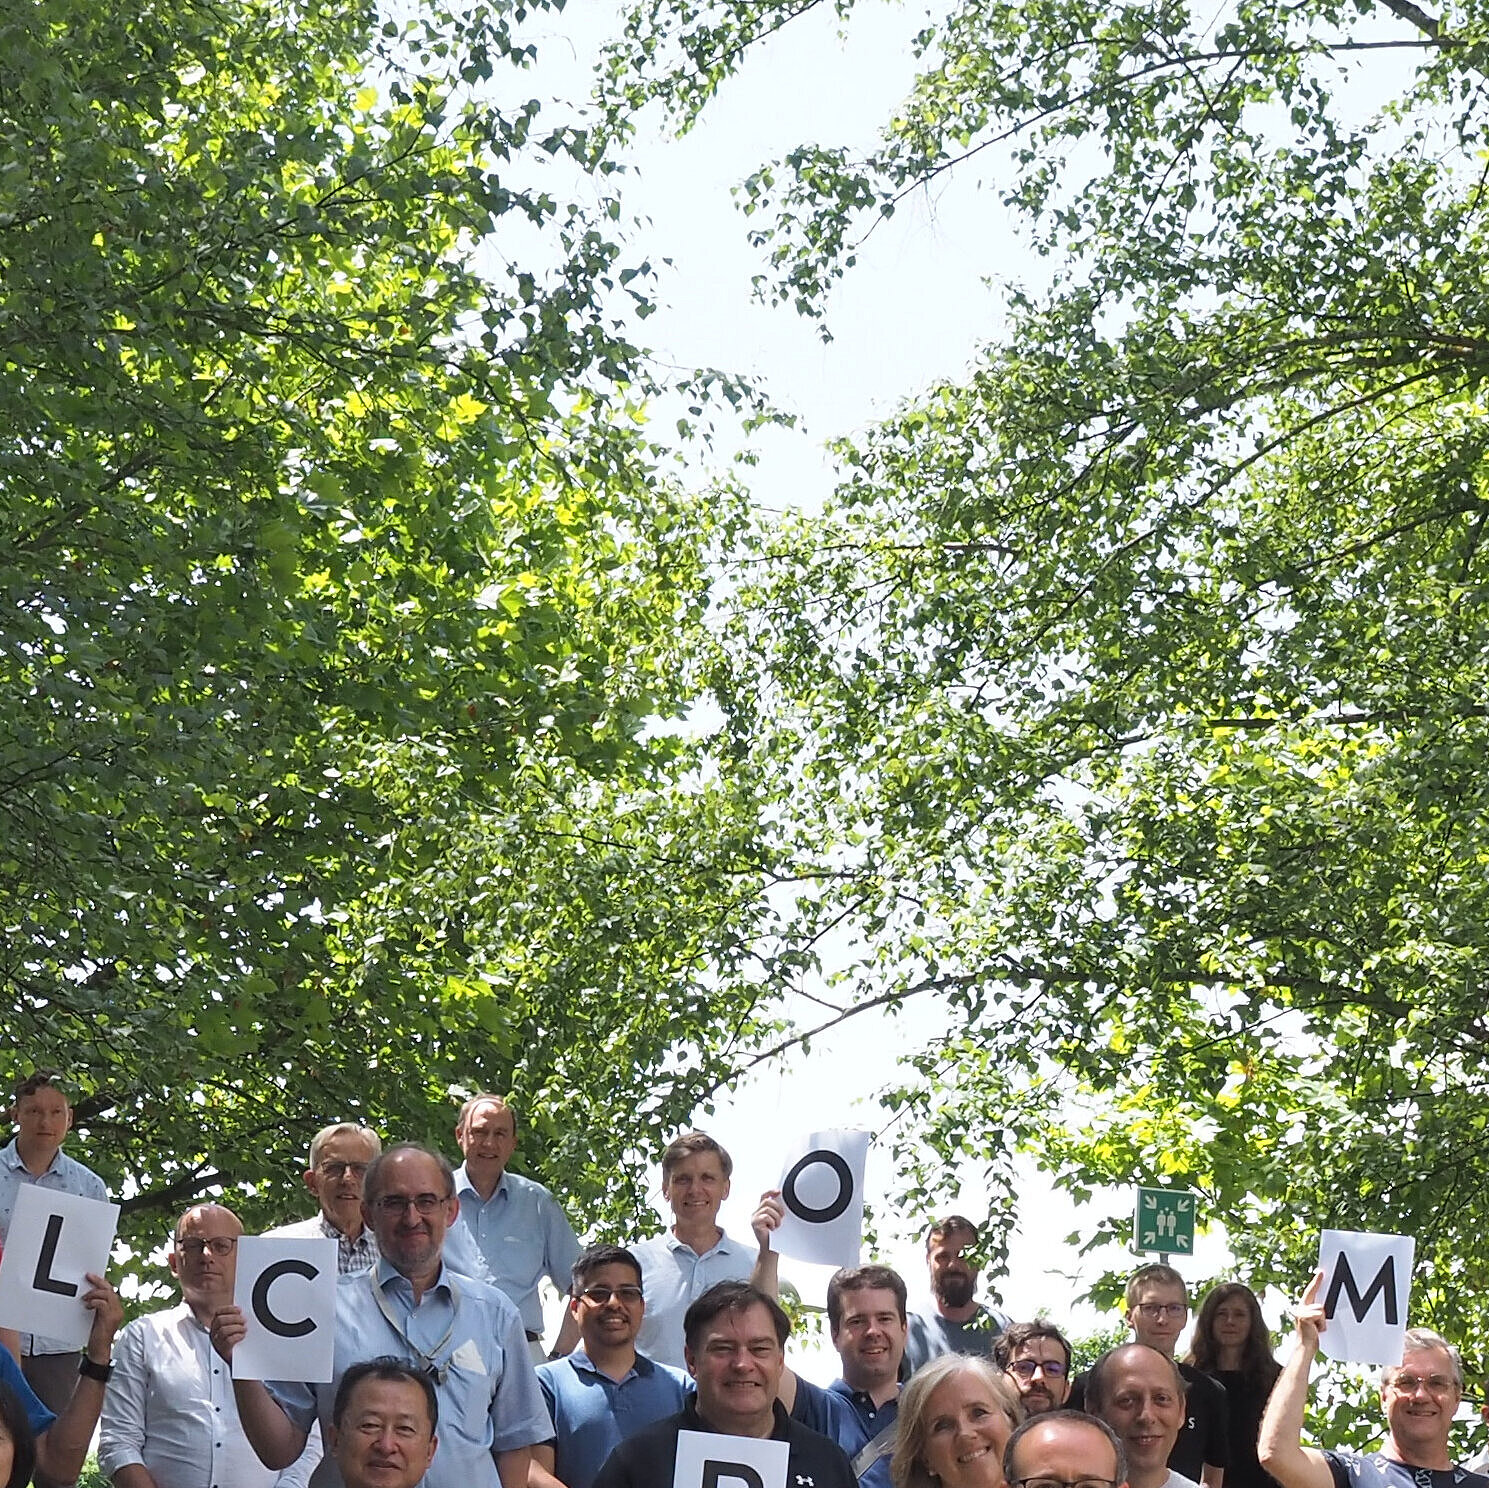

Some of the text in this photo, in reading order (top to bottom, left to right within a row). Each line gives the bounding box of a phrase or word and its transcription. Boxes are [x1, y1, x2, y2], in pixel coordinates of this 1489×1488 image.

[781, 1149, 854, 1224] O
[32, 1214, 79, 1298] L
[1322, 1250, 1399, 1326] M
[251, 1259, 320, 1338] C
